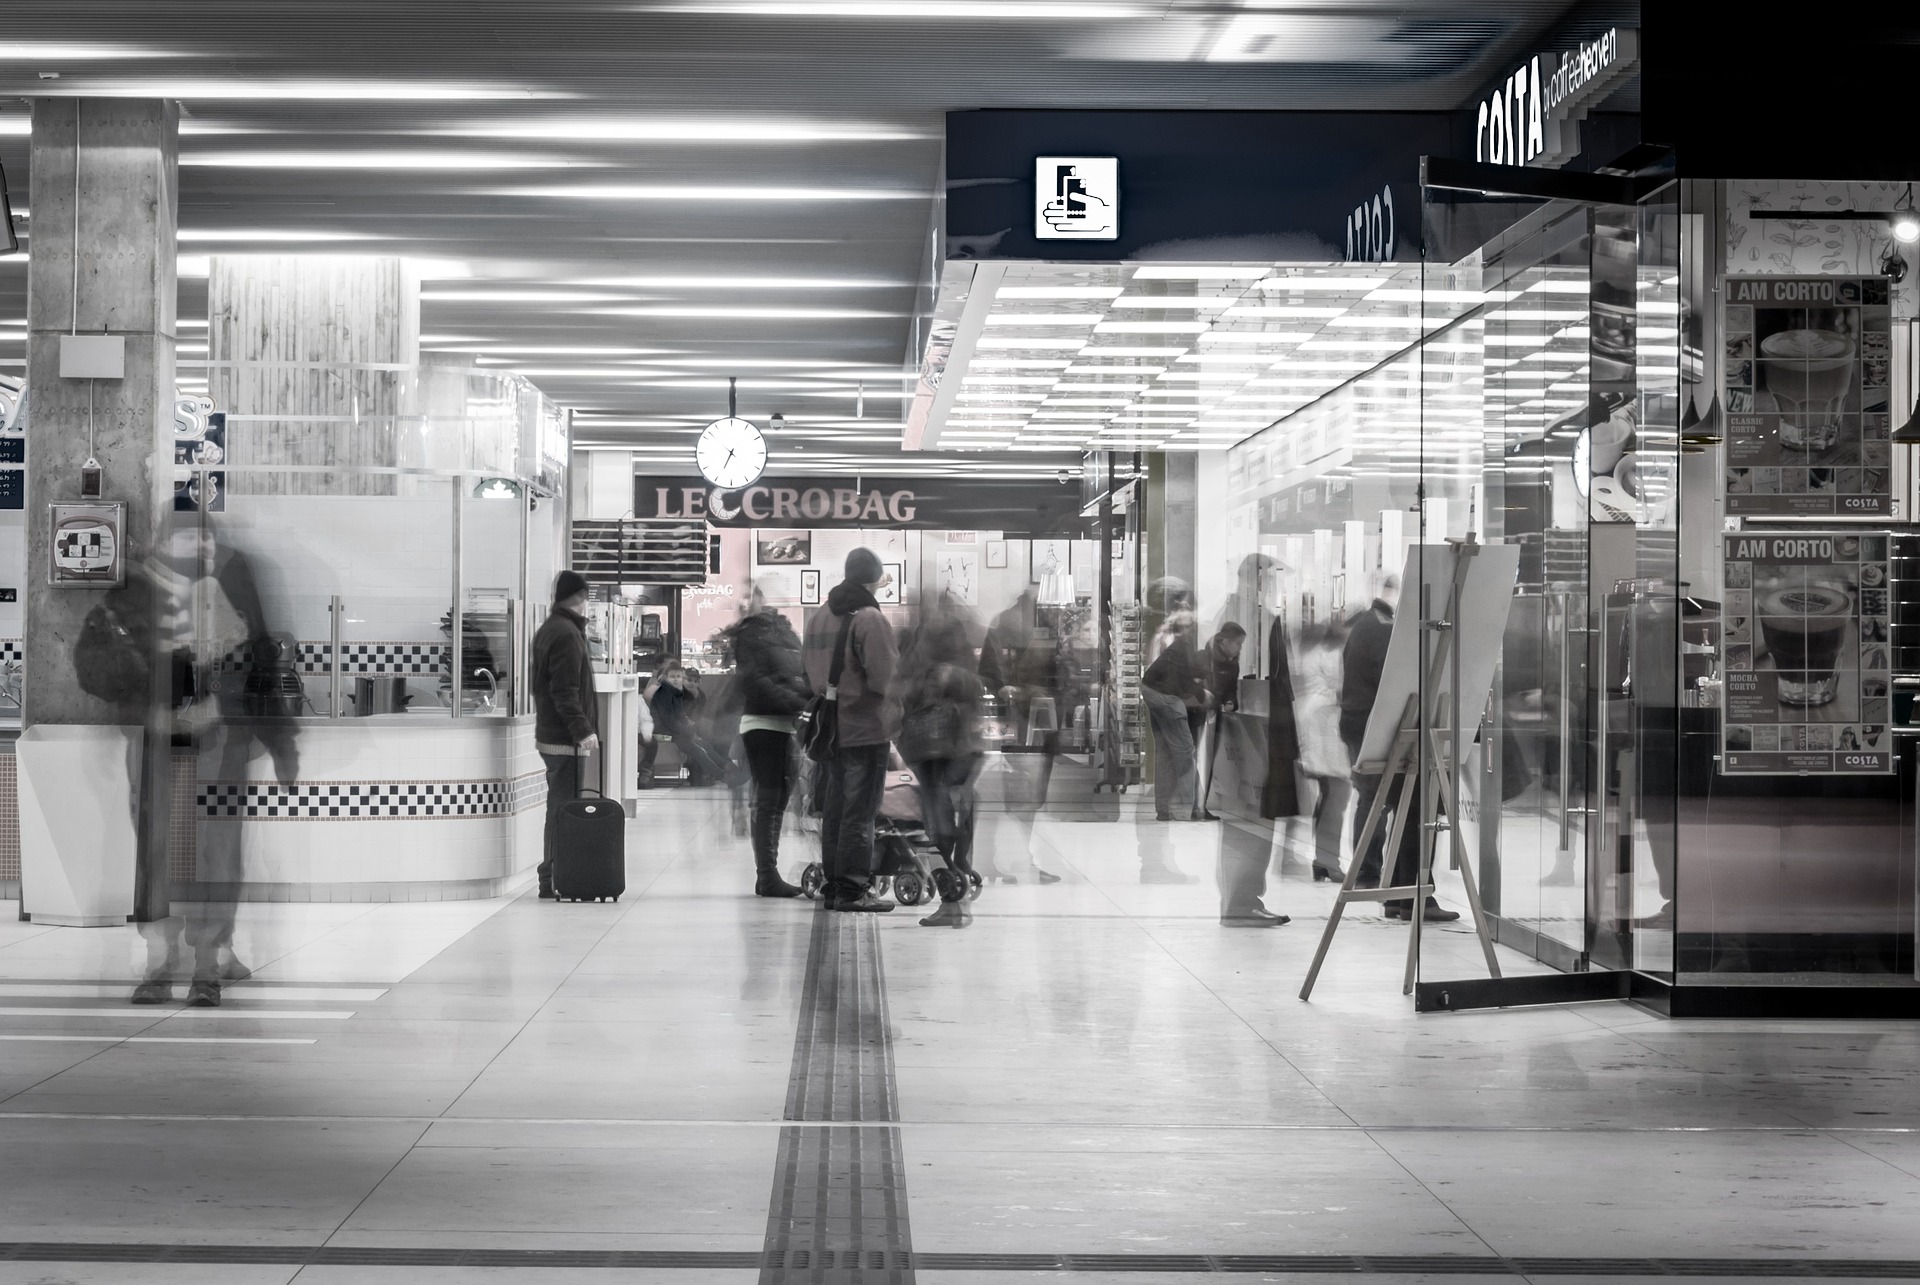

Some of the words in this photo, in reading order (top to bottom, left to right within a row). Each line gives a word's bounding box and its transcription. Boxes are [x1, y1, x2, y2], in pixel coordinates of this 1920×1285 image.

[1550, 26, 1617, 108] coffeeheaven
[1726, 281, 1732, 301] I
[1737, 281, 1767, 301] AM
[1774, 281, 1833, 301] CORTO
[1730, 417, 1764, 425] CLASSIC
[1730, 425, 1756, 433] CORTO
[655, 487, 707, 518] LE
[741, 486, 916, 522] CROBAG
[1845, 498, 1879, 508] COSTA
[1725, 540, 1731, 559] I
[1737, 540, 1766, 559] AM
[1772, 540, 1831, 559] CORTO
[1729, 674, 1758, 682] MOCHA
[1729, 683, 1756, 691] CORTO
[1845, 755, 1879, 765] COSTA
